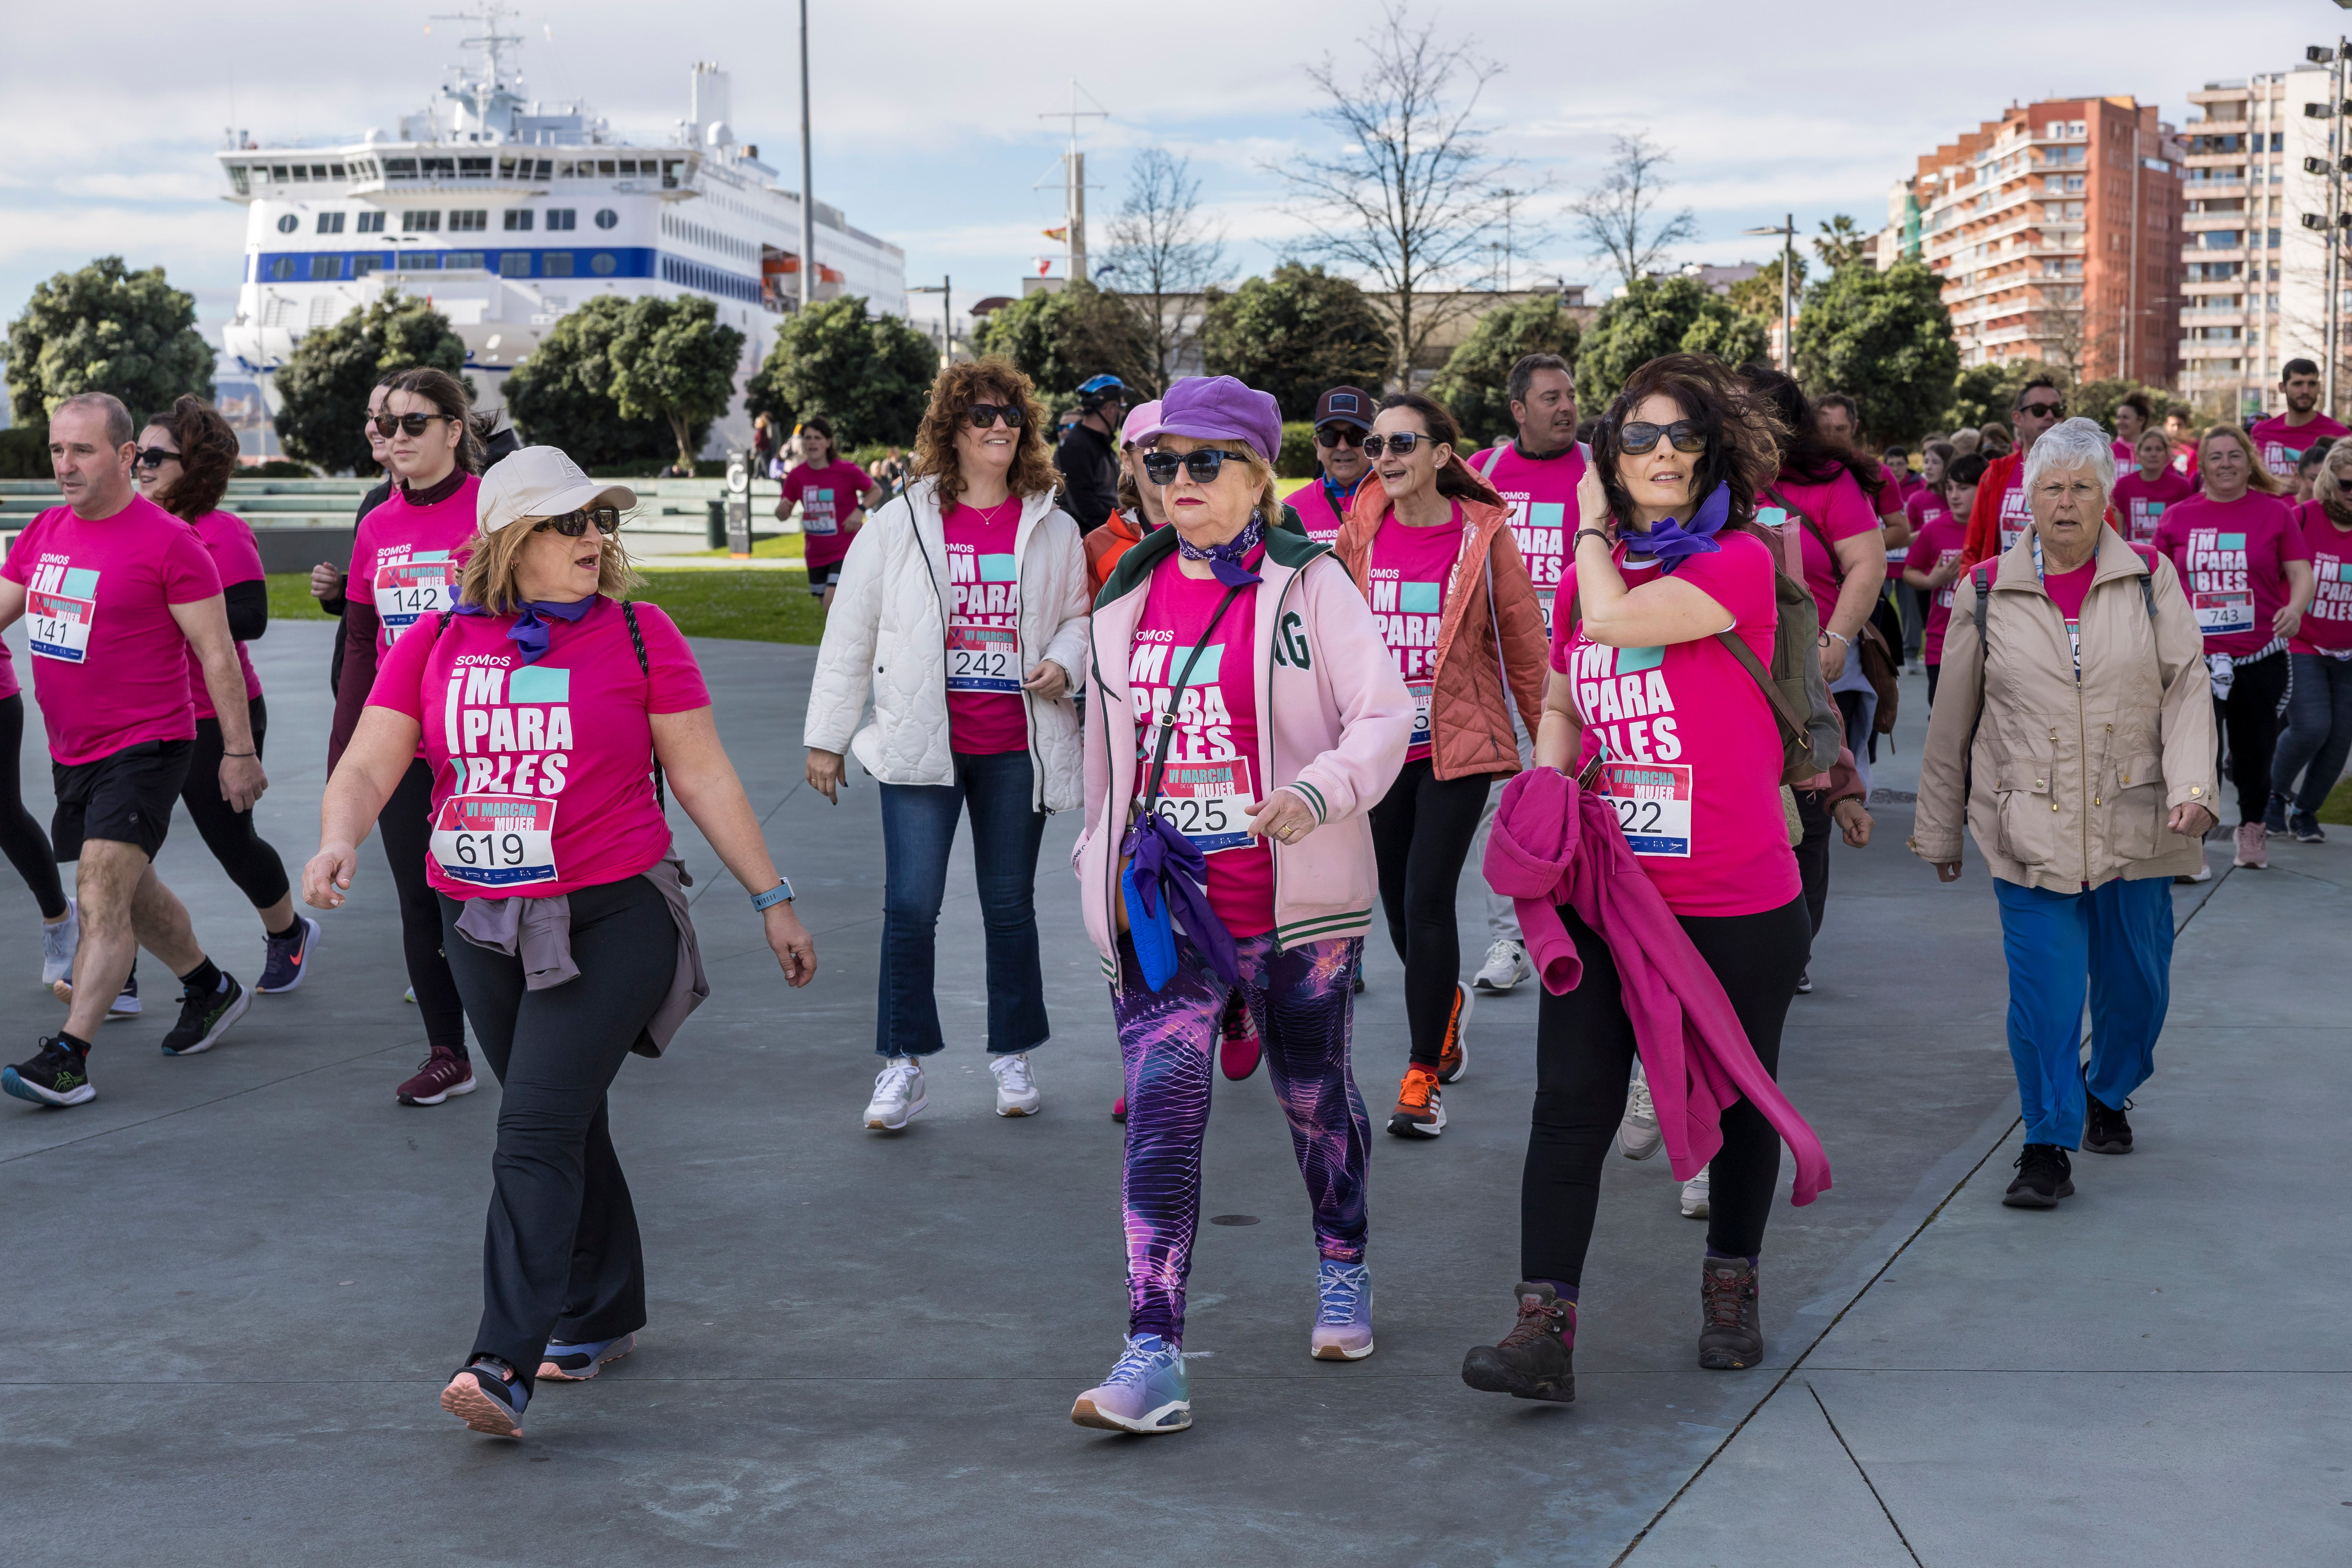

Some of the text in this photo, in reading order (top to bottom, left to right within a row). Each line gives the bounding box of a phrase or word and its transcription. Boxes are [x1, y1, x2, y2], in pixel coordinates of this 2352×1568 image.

[552, 452, 587, 479] A
[1499, 492, 1530, 500] SOMOS
[1307, 530, 1338, 539] SOMOS
[377, 544, 411, 557] SOMOS
[945, 543, 975, 553] OMOS
[40, 553, 69, 565] SOMOS
[2196, 550, 2248, 571] PARA
[2315, 552, 2340, 563] SOMOS
[399, 567, 445, 578] VI MARCHA
[1371, 569, 1399, 579] OMOS
[417, 577, 446, 587] MUJER
[2197, 571, 2248, 592] BLES
[2317, 580, 2352, 602] PAR
[44, 597, 82, 614] VI MARCHA
[394, 588, 438, 612] 142
[56, 610, 81, 623] MUJER
[2210, 610, 2238, 623] 743
[37, 618, 67, 644] 141
[965, 630, 1014, 642] VI MARCHA
[1136, 629, 1174, 642] OMOS
[986, 641, 1014, 653] MUJER
[455, 654, 511, 666] SOMOS
[955, 652, 1005, 677] 242
[1392, 649, 1438, 680] LES
[1408, 686, 1432, 697] RCHA
[1580, 670, 1675, 724] PARA
[463, 707, 573, 753] PARA
[467, 753, 569, 795] BLES
[1169, 768, 1234, 783] VI MARCHA
[1614, 769, 1675, 786] VI MARCHA
[1194, 782, 1235, 797] MUJER
[1634, 785, 1675, 800] MUJER
[466, 802, 536, 817] VI MARCHA
[1159, 799, 1227, 832] 625
[495, 817, 535, 831] MUJER
[456, 833, 524, 866] 619
